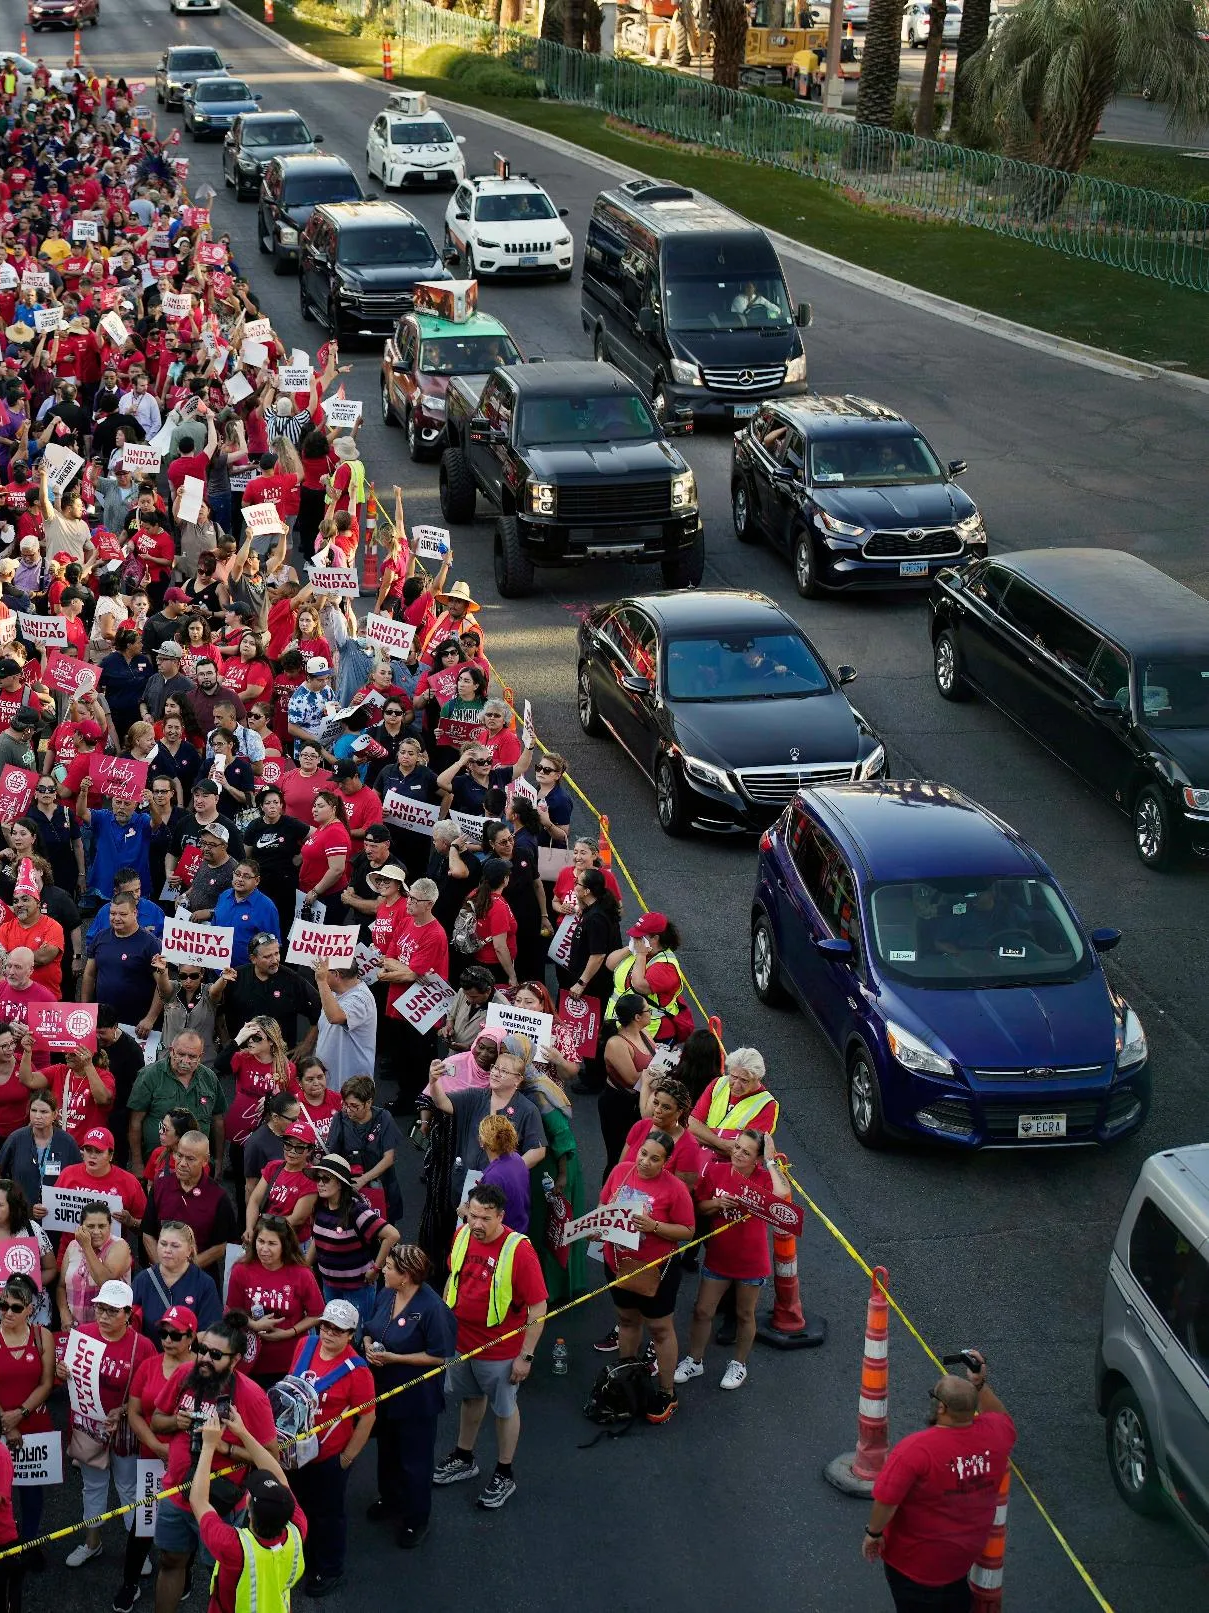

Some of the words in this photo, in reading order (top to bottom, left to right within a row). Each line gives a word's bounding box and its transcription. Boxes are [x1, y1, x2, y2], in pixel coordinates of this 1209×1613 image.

[402, 145, 450, 154] 3756
[284, 378, 308, 386] SUFICIENTE
[331, 413, 356, 421] SUFICIENTE
[124, 456, 160, 466] UNIDAD
[127, 448, 156, 458] UNITY
[56, 459, 77, 486] SUFICIENTE
[250, 509, 275, 519] UNIT
[311, 580, 357, 589] UNIDAD
[314, 572, 351, 581] UNITY
[21, 626, 66, 639] UNIDAD
[23, 619, 60, 631] UNITY
[371, 620, 409, 640] UNITY
[367, 629, 410, 649] UNIDAD
[99, 757, 136, 784] Unity
[101, 782, 137, 799] Unidad
[390, 800, 432, 817] UNITY
[171, 927, 225, 943] UNITY
[301, 928, 352, 944] UNITY
[164, 937, 230, 958] UNIDAD
[292, 939, 354, 958] UNIDAD
[405, 977, 444, 1011] UNITY
[409, 987, 456, 1023] UNIDAD
[499, 1011, 513, 1019] UN
[513, 1013, 541, 1026] EMPLEO
[1036, 1121, 1060, 1133] ECRA
[55, 1193, 71, 1201] UN
[54, 1206, 82, 1224] SUFIC
[71, 1338, 89, 1415] UNIDAD
[82, 1349, 99, 1416] UNITY
[11, 1445, 48, 1463] SUFICIE
[35, 1471, 48, 1479] UN
[144, 1511, 154, 1525] UN
